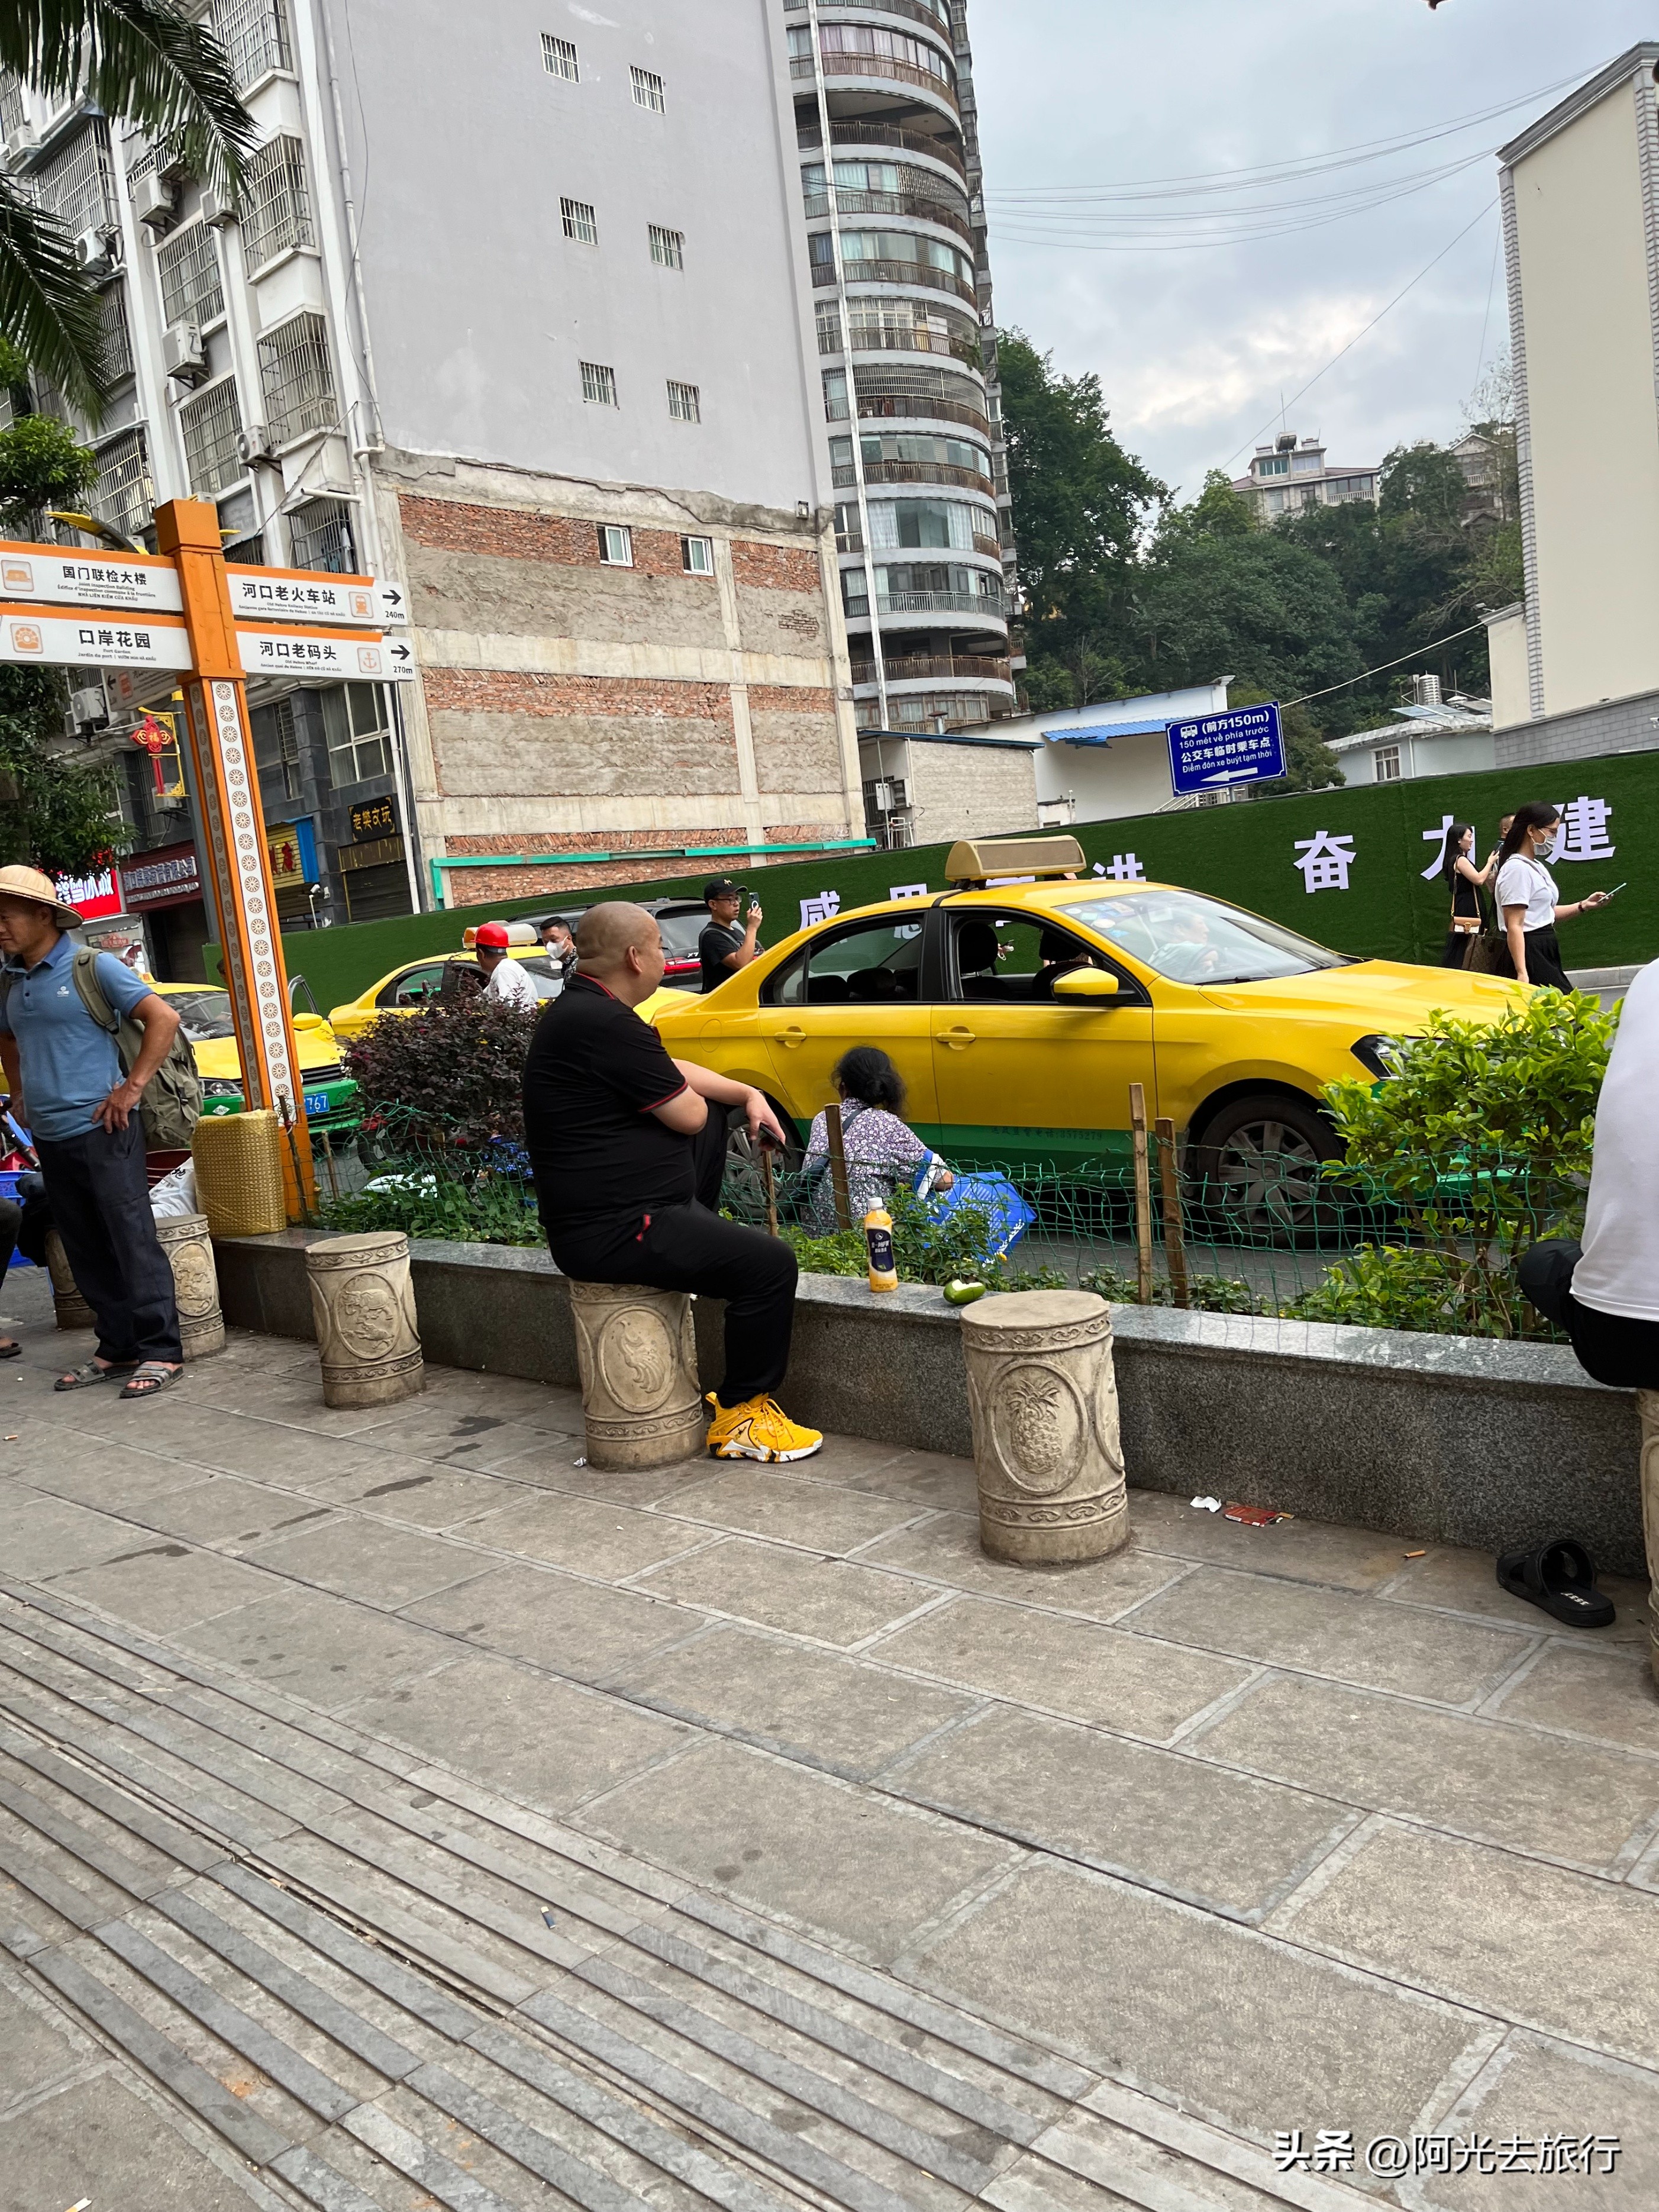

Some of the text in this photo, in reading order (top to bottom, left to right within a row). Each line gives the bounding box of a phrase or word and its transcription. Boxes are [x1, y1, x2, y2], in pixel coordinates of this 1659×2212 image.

[63, 566, 147, 585] 国门联检大楼
[242, 582, 335, 605] 河口老火车站
[385, 611, 405, 619] 240m
[79, 629, 150, 649] 口岸花园
[260, 641, 337, 660] 河口老码头
[393, 666, 412, 674] 270m
[1202, 710, 1270, 734] (前方150m)
[1179, 725, 1270, 749] 150 mét về phía trước
[1181, 737, 1271, 763] 公交车临时乘车点
[1183, 763, 1201, 773] Điểm
[1202, 760, 1215, 770] đón
[1226, 755, 1242, 766] buýt
[1243, 753, 1257, 762] tạm
[1257, 750, 1272, 760] thời
[304, 1095, 327, 1110] 767
